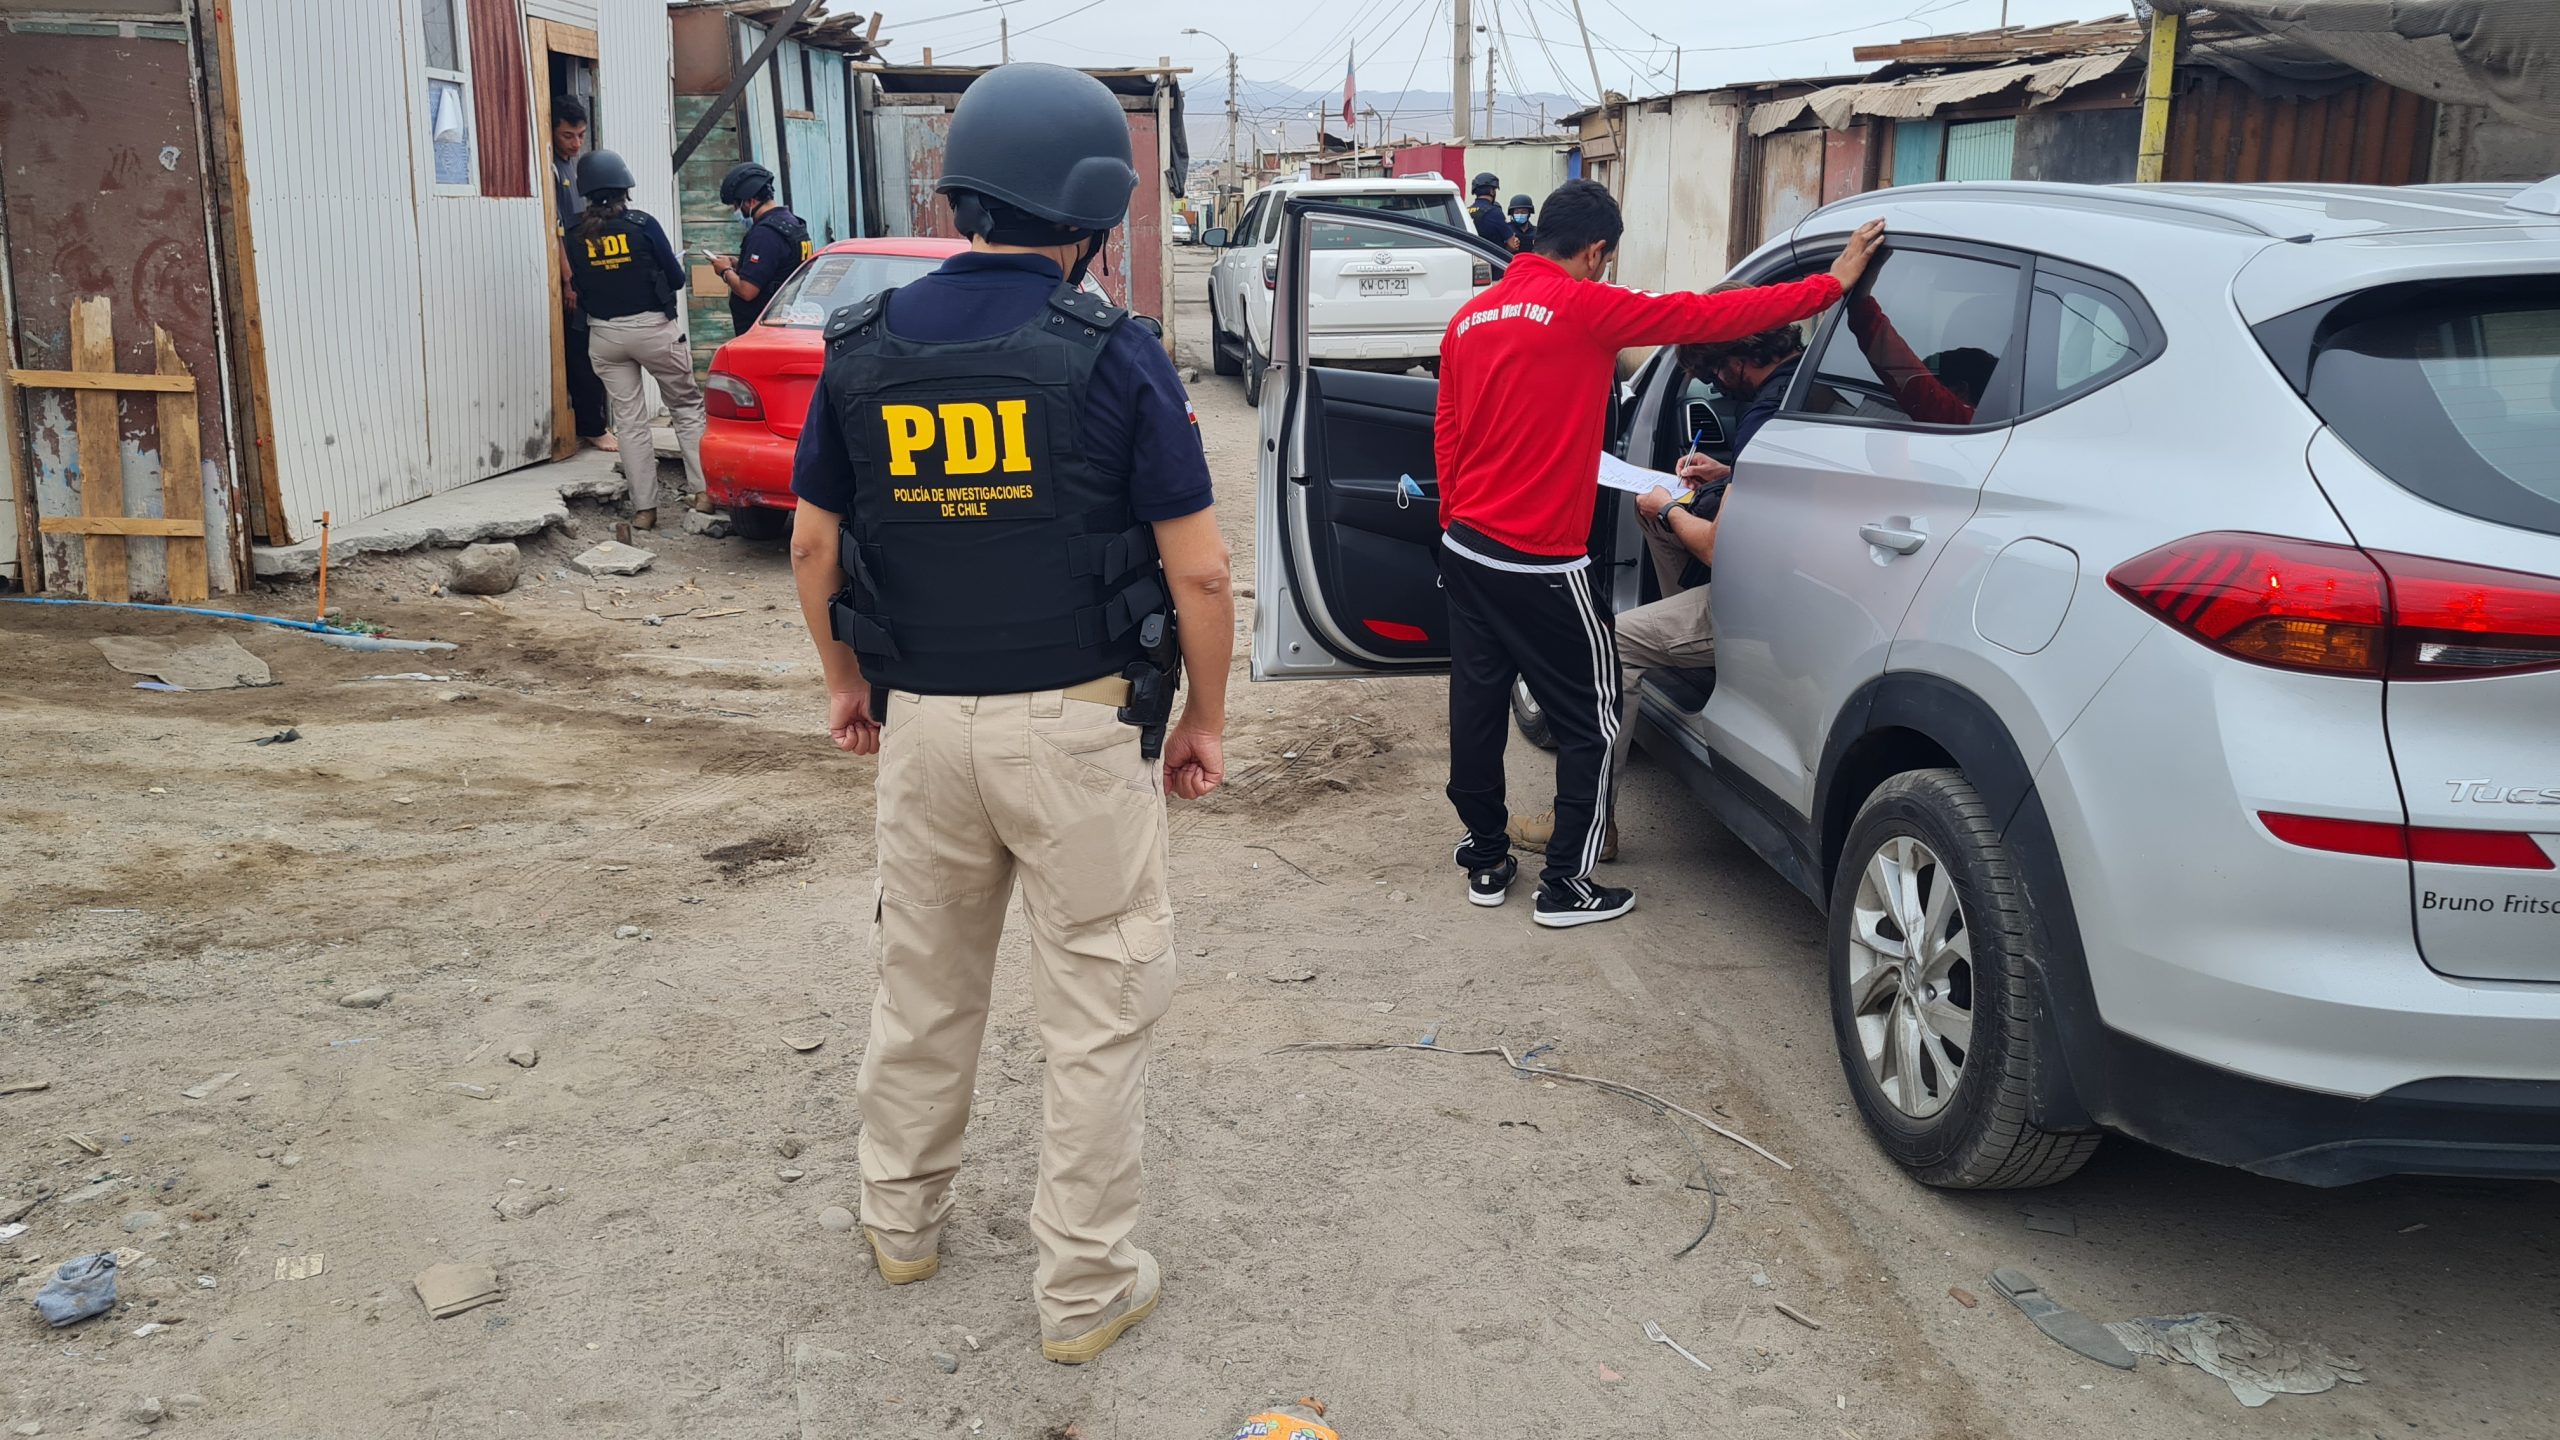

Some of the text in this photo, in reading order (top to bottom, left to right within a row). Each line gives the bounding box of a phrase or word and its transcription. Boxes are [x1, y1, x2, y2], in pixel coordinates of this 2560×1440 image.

[1471, 308, 1499, 326] Essen
[1501, 302, 1523, 319] West
[1524, 302, 1554, 326] 1881
[882, 400, 1032, 476] PDI
[894, 484, 1033, 502] POLICÍA DE INVESTIGACIONES
[941, 502, 988, 517] DE CHILE
[2422, 891, 2494, 912] Bruno
